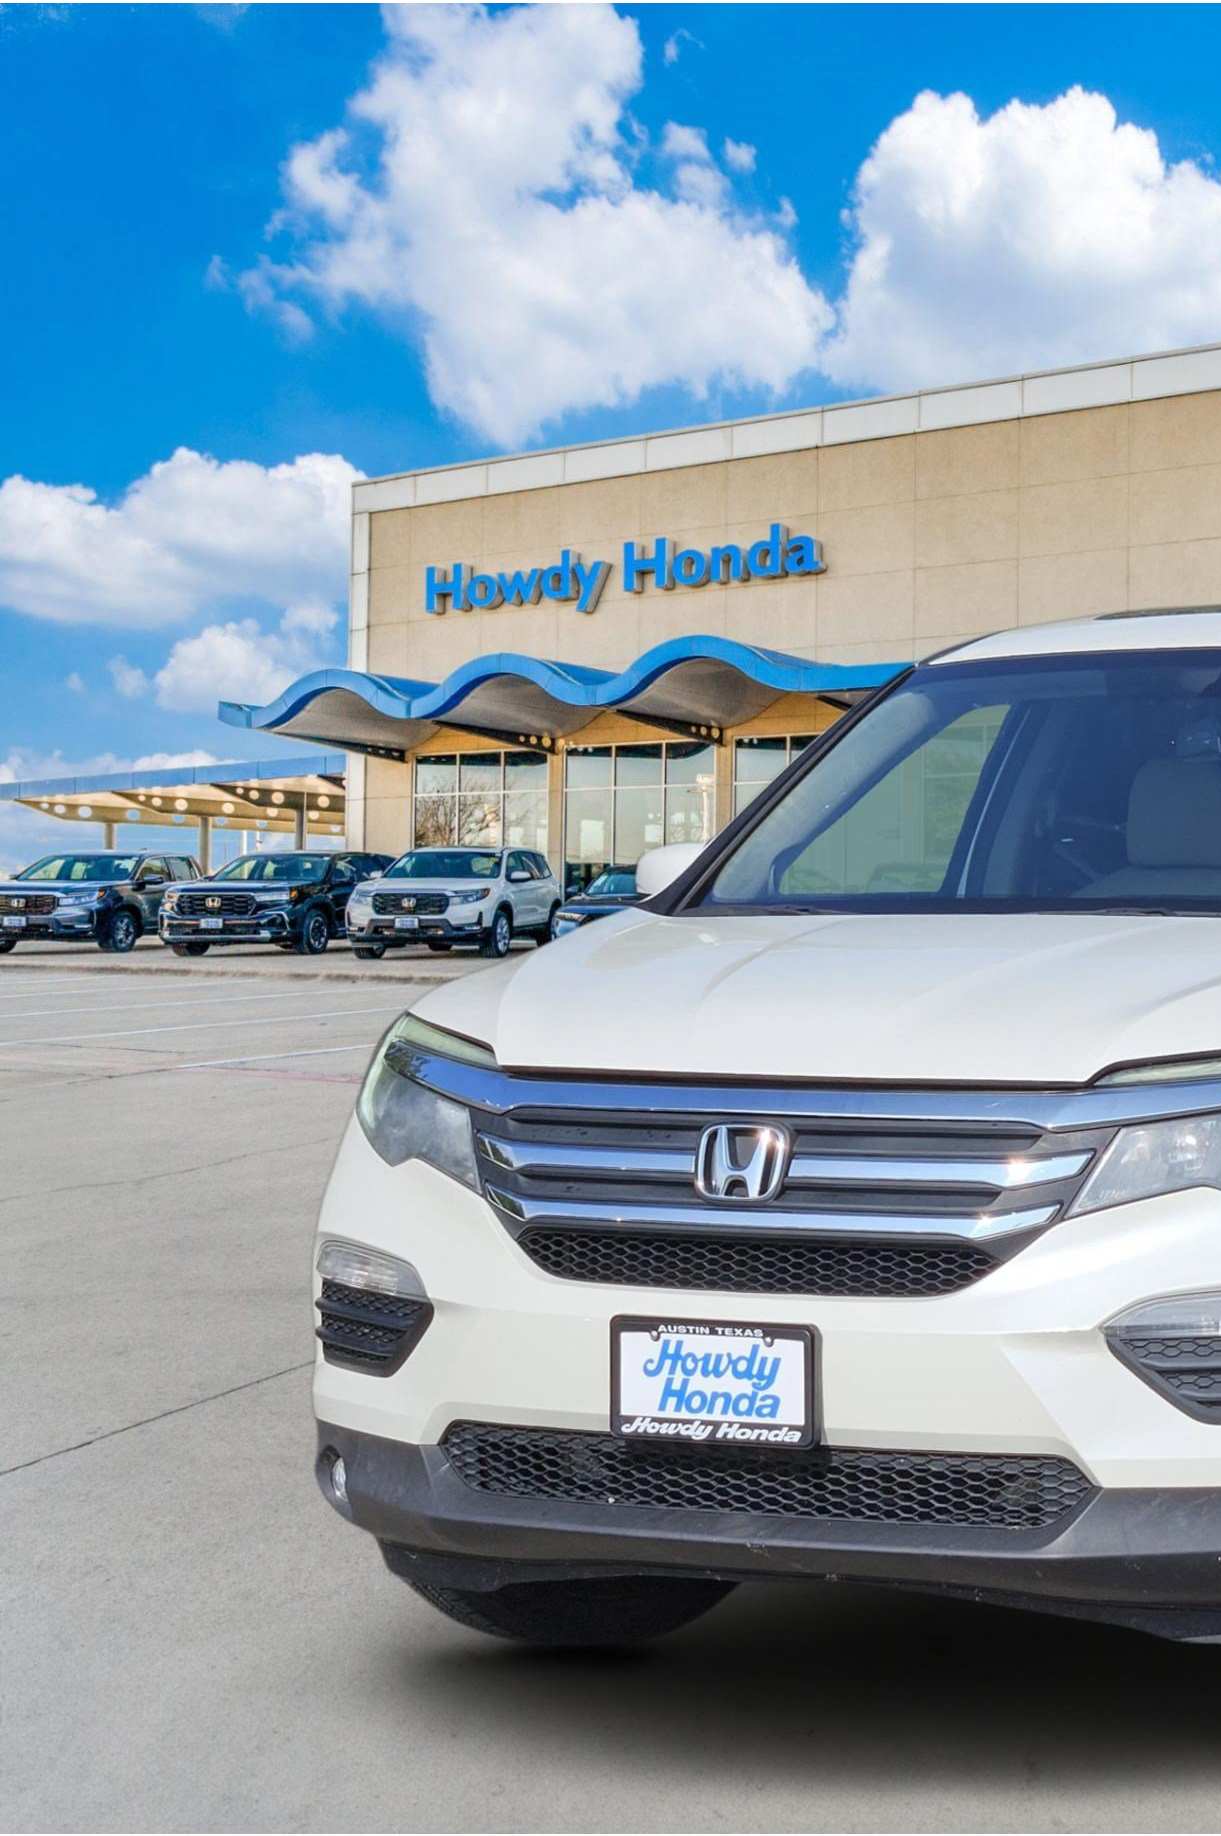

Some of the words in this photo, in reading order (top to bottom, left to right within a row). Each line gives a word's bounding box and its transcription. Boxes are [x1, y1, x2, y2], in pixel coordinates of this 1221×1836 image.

[425, 549, 612, 615] Howdy
[623, 523, 827, 593] Honda
[657, 1324, 710, 1335] AUSTIN
[715, 1327, 764, 1338] TEXAS
[643, 1339, 782, 1391] Howdy
[657, 1377, 782, 1419] Honda
[621, 1417, 715, 1441] Howdy
[716, 1423, 802, 1443] Honda
